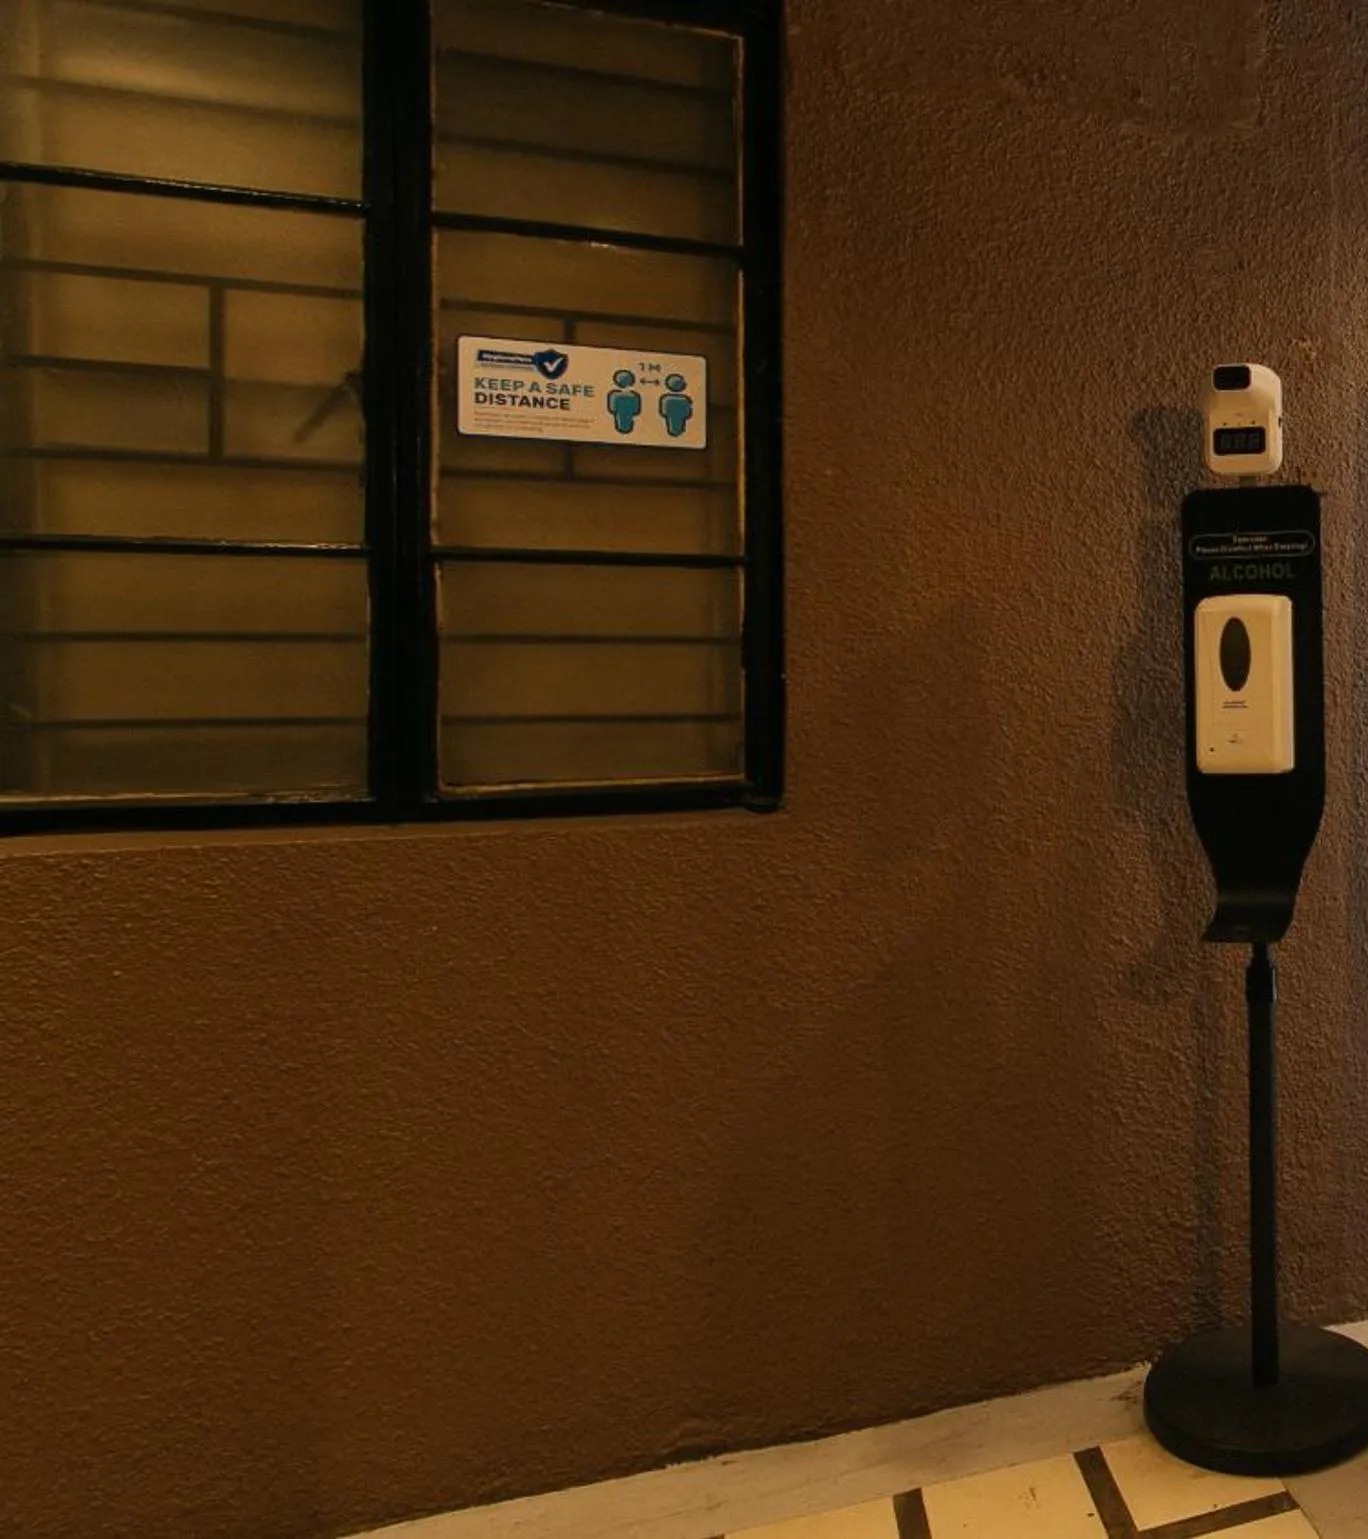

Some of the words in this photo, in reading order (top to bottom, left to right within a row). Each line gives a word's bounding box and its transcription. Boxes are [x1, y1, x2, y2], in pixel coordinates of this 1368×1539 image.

[474, 377, 525, 392] KEEP
[528, 381, 541, 393] A
[546, 382, 595, 398] SAFE
[474, 391, 571, 410] DISTANCE
[1210, 562, 1296, 581] ALCOHOL
